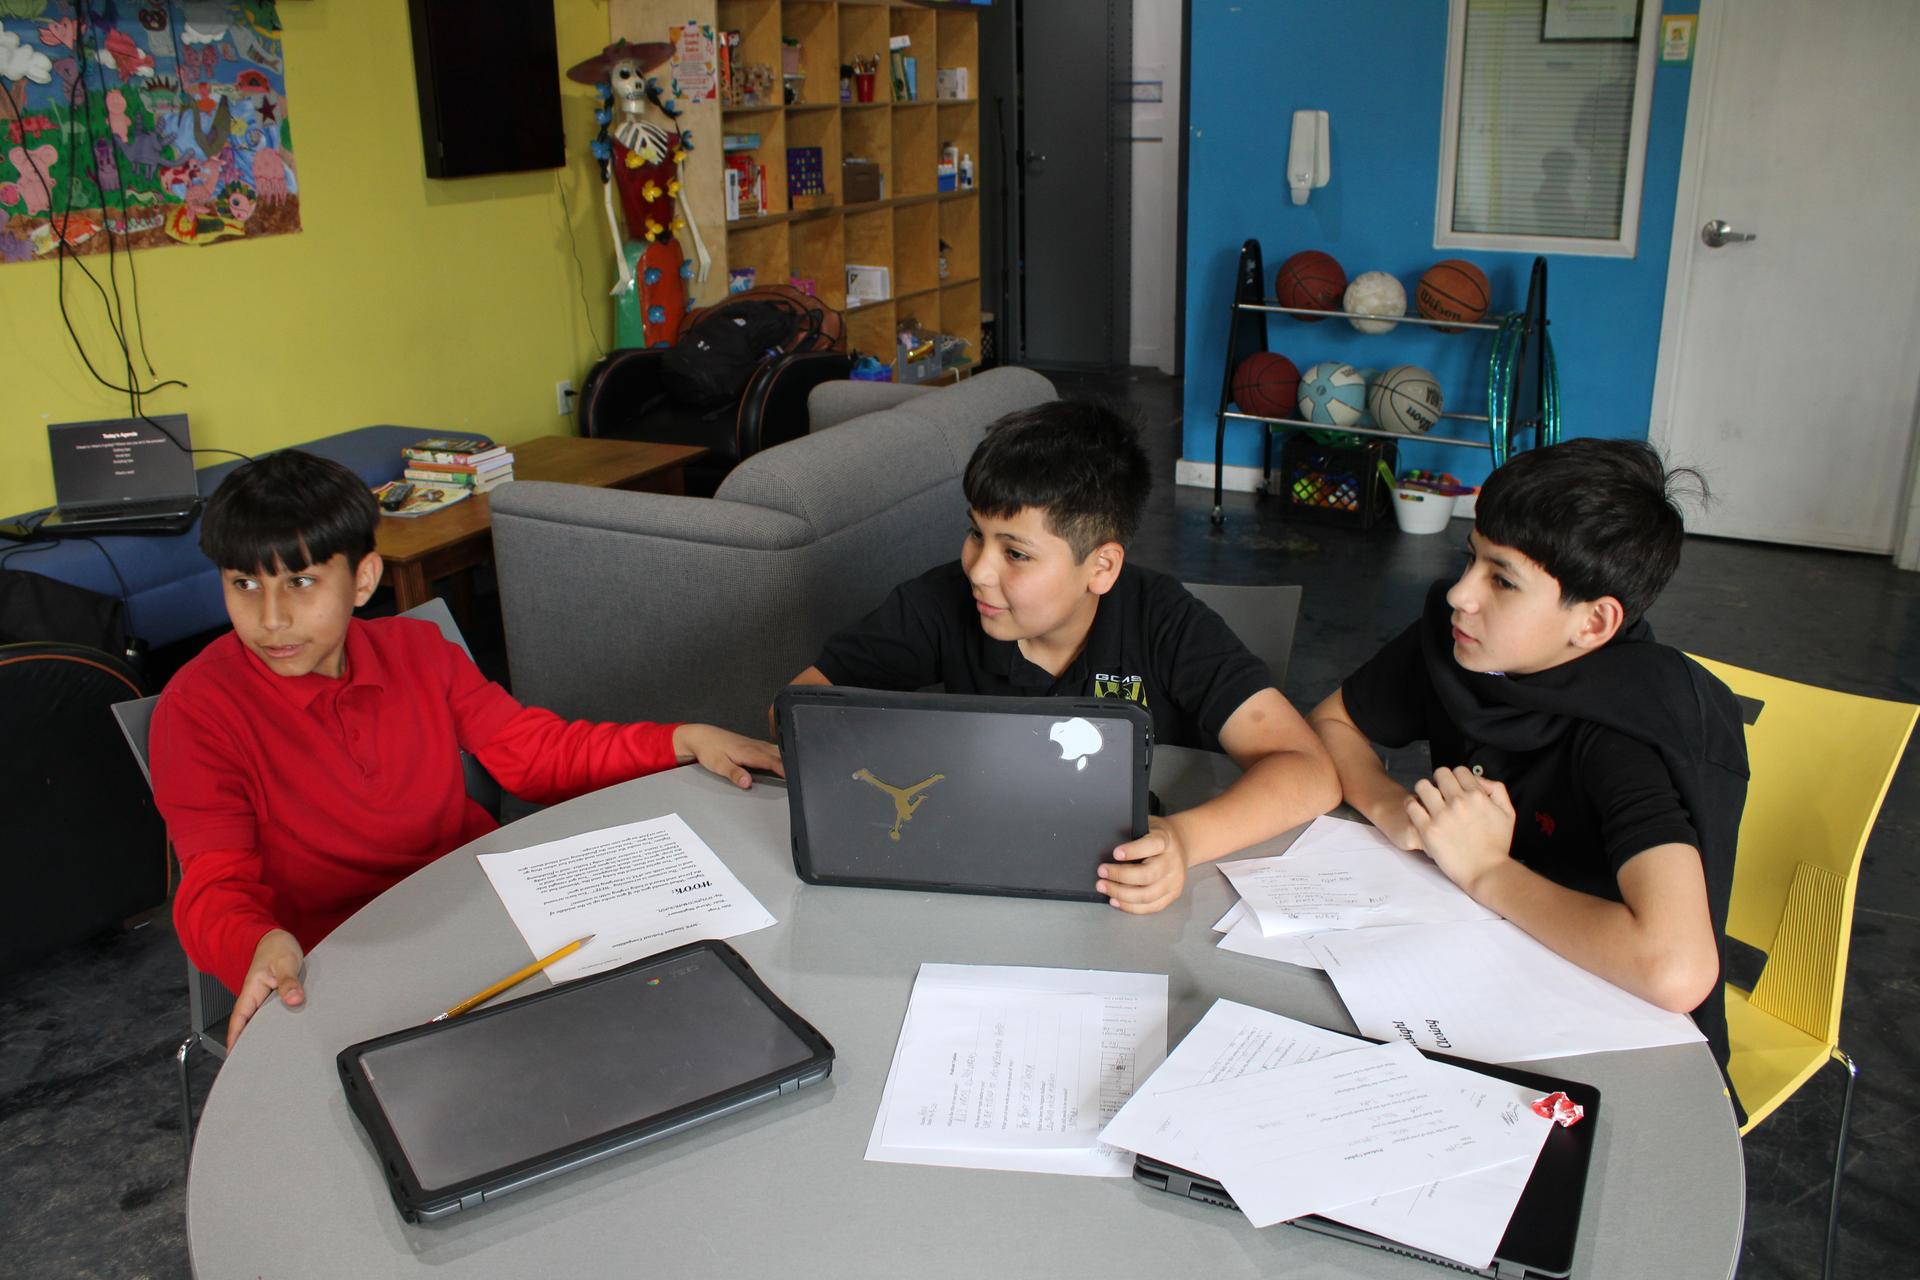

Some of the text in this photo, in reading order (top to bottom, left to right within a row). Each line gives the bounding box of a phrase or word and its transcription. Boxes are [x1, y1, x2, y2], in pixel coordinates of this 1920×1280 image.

[1419, 287, 1462, 321] Wilson
[672, 881, 712, 894] HOOK:
[1426, 1019, 1453, 1048] Closing
